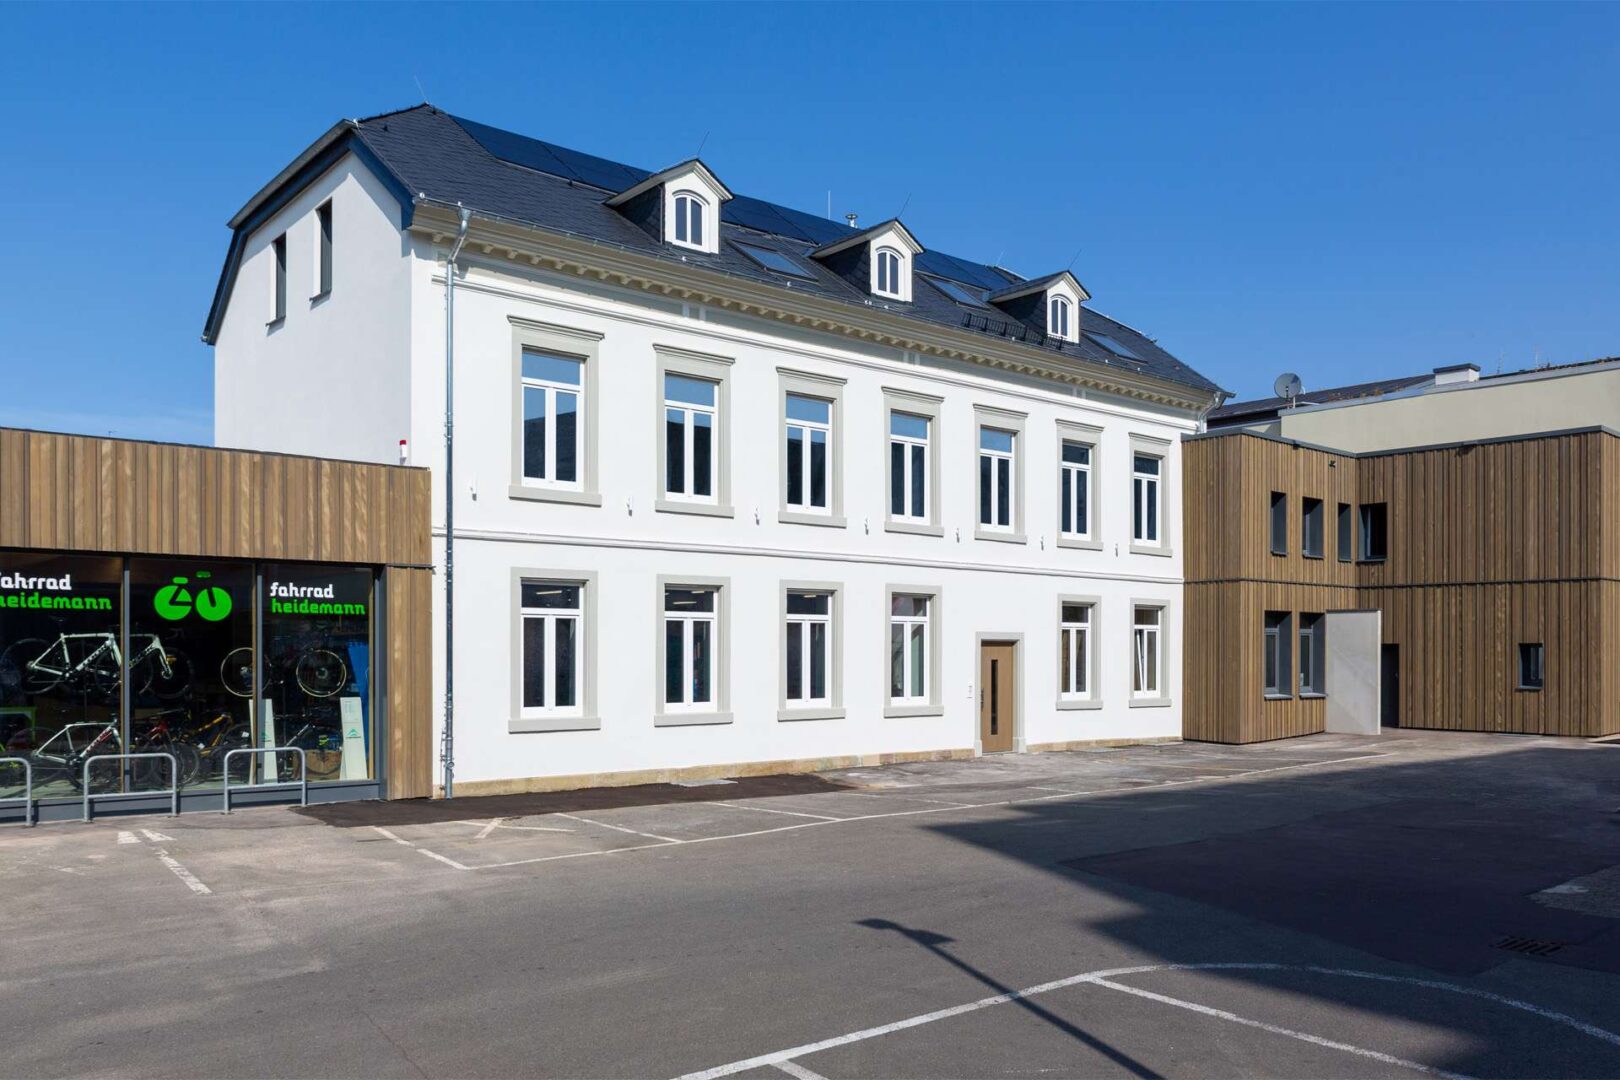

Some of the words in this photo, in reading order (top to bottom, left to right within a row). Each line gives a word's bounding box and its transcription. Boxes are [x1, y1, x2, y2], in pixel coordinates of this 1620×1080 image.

[0, 572, 72, 590] ahrrad
[270, 581, 334, 598] fahrrad
[271, 598, 365, 615] heidemann
